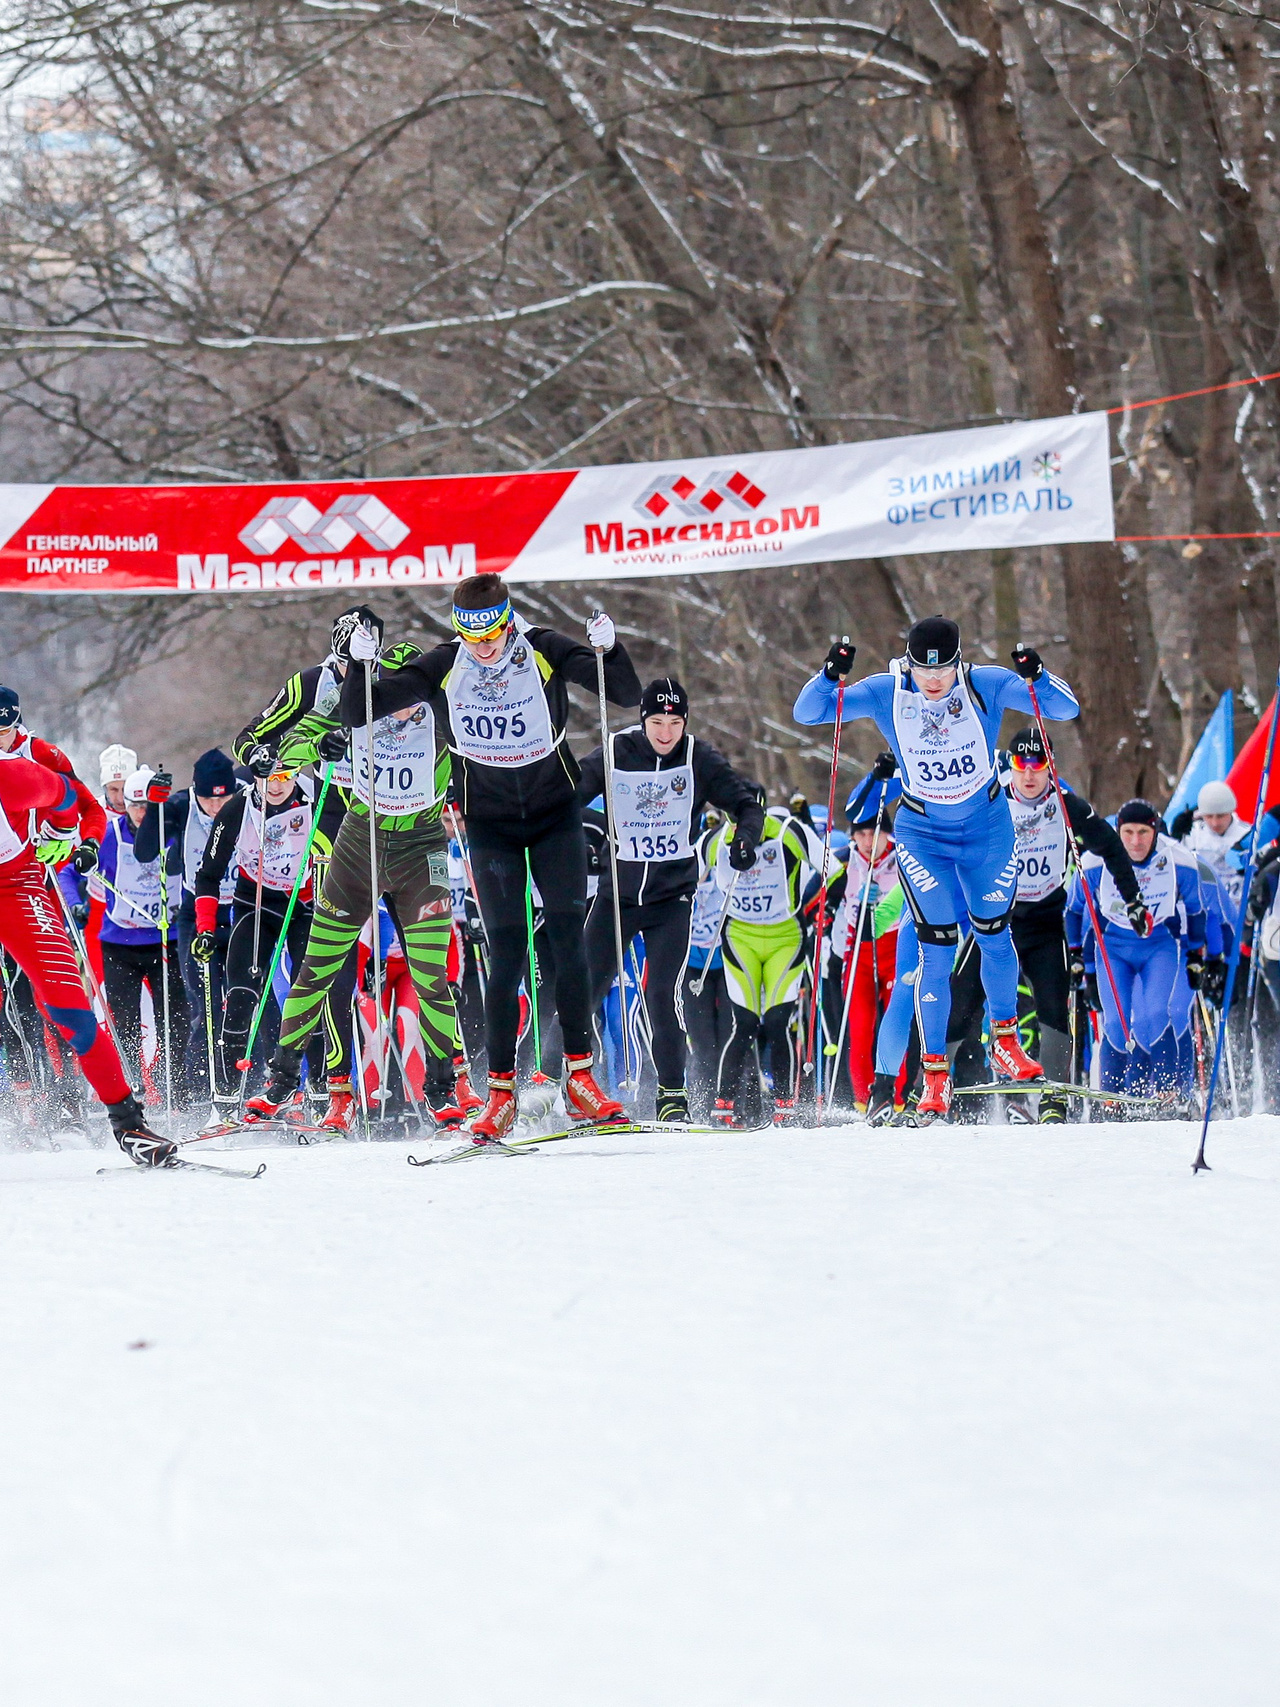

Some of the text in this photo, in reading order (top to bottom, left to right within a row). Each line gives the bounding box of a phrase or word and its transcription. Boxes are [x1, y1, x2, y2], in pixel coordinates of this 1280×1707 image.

[887, 456, 1022, 498] ЗИМНИЙ
[886, 487, 1074, 526] ФЕСТИВАЛЬ
[26, 532, 159, 552] ГЕНЕРАЛЬНЫЙ
[583, 505, 820, 555] МаксидоМ
[26, 557, 110, 575] ПАРТНЕР
[176, 543, 477, 590] МаксидоМ
[456, 609, 501, 624] LUKOIL
[656, 692, 681, 705] DNB
[461, 711, 527, 740] 3095
[364, 748, 425, 762] сортмастер
[493, 753, 525, 763] РОССИИ
[1017, 738, 1041, 754] DNB
[917, 754, 977, 782] 3348
[629, 819, 682, 829] спортмасте
[640, 809, 666, 819] РОССИИ
[895, 842, 939, 893] SATURN
[28, 894, 54, 934] Swix
[568, 1077, 603, 1111] alpina
